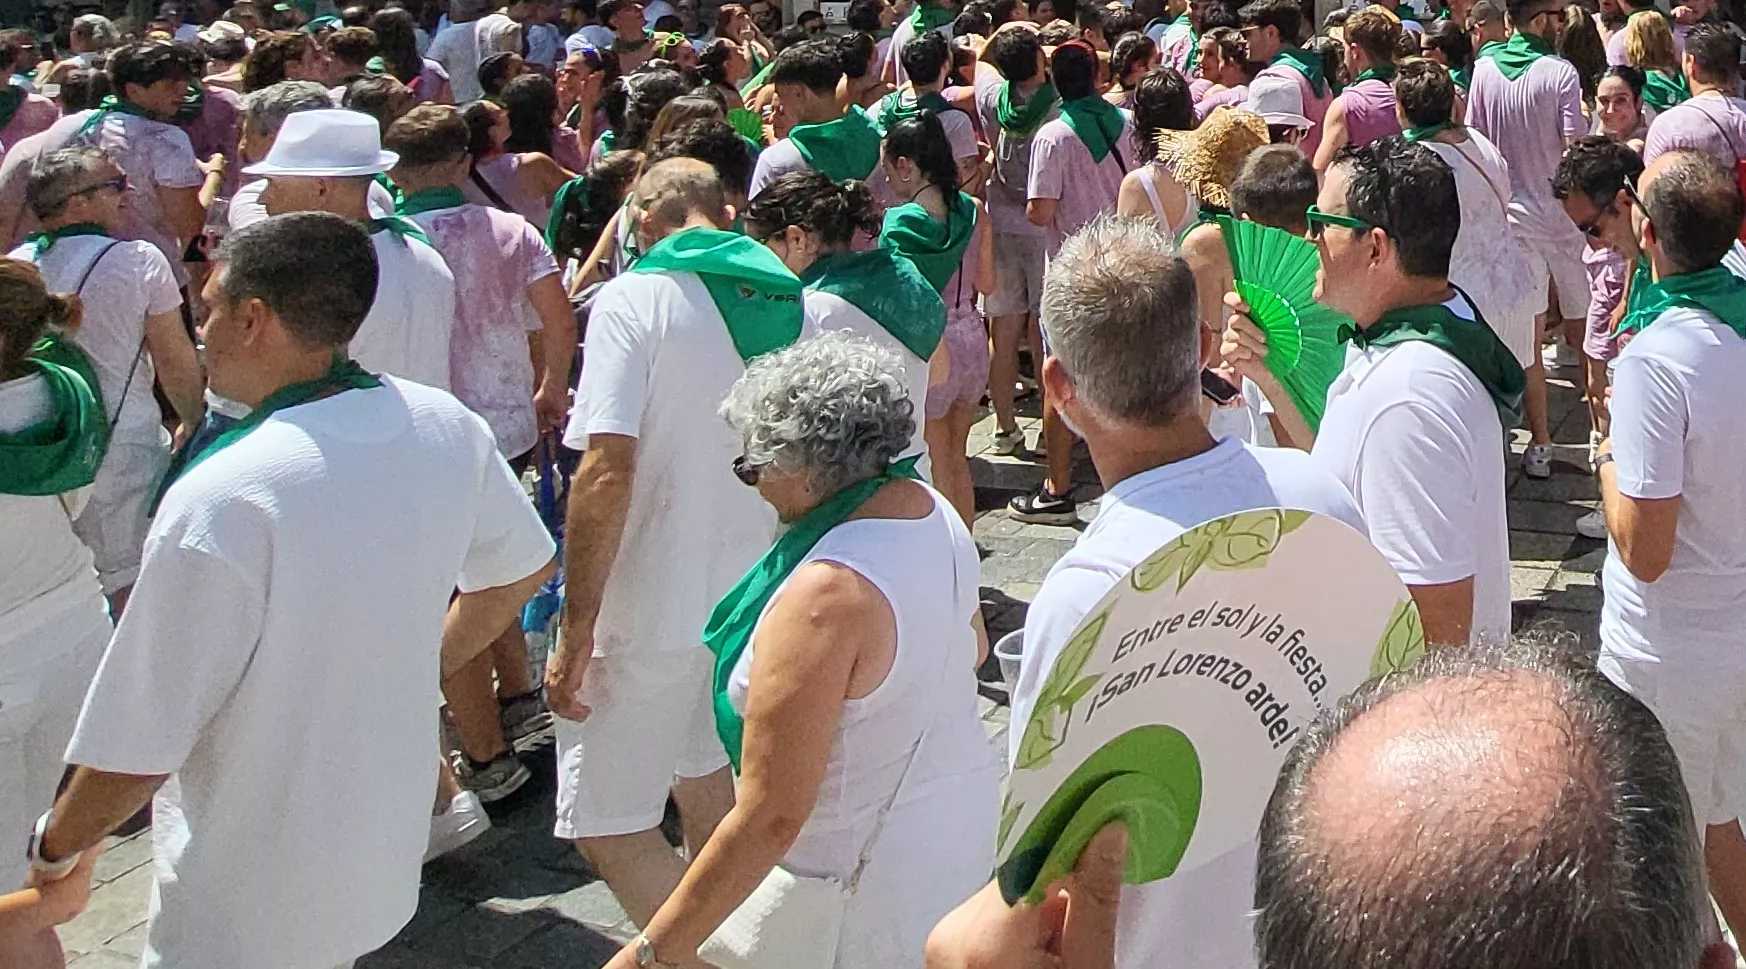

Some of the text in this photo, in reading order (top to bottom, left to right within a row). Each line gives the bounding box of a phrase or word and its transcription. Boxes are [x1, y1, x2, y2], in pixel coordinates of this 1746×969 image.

[1111, 612, 1185, 664] Entre
[1187, 600, 1219, 630] el
[1211, 603, 1256, 630] sol
[1239, 612, 1268, 639] y
[1259, 613, 1286, 645] la
[1085, 648, 1301, 750] ¡San Lorenzo arde!
